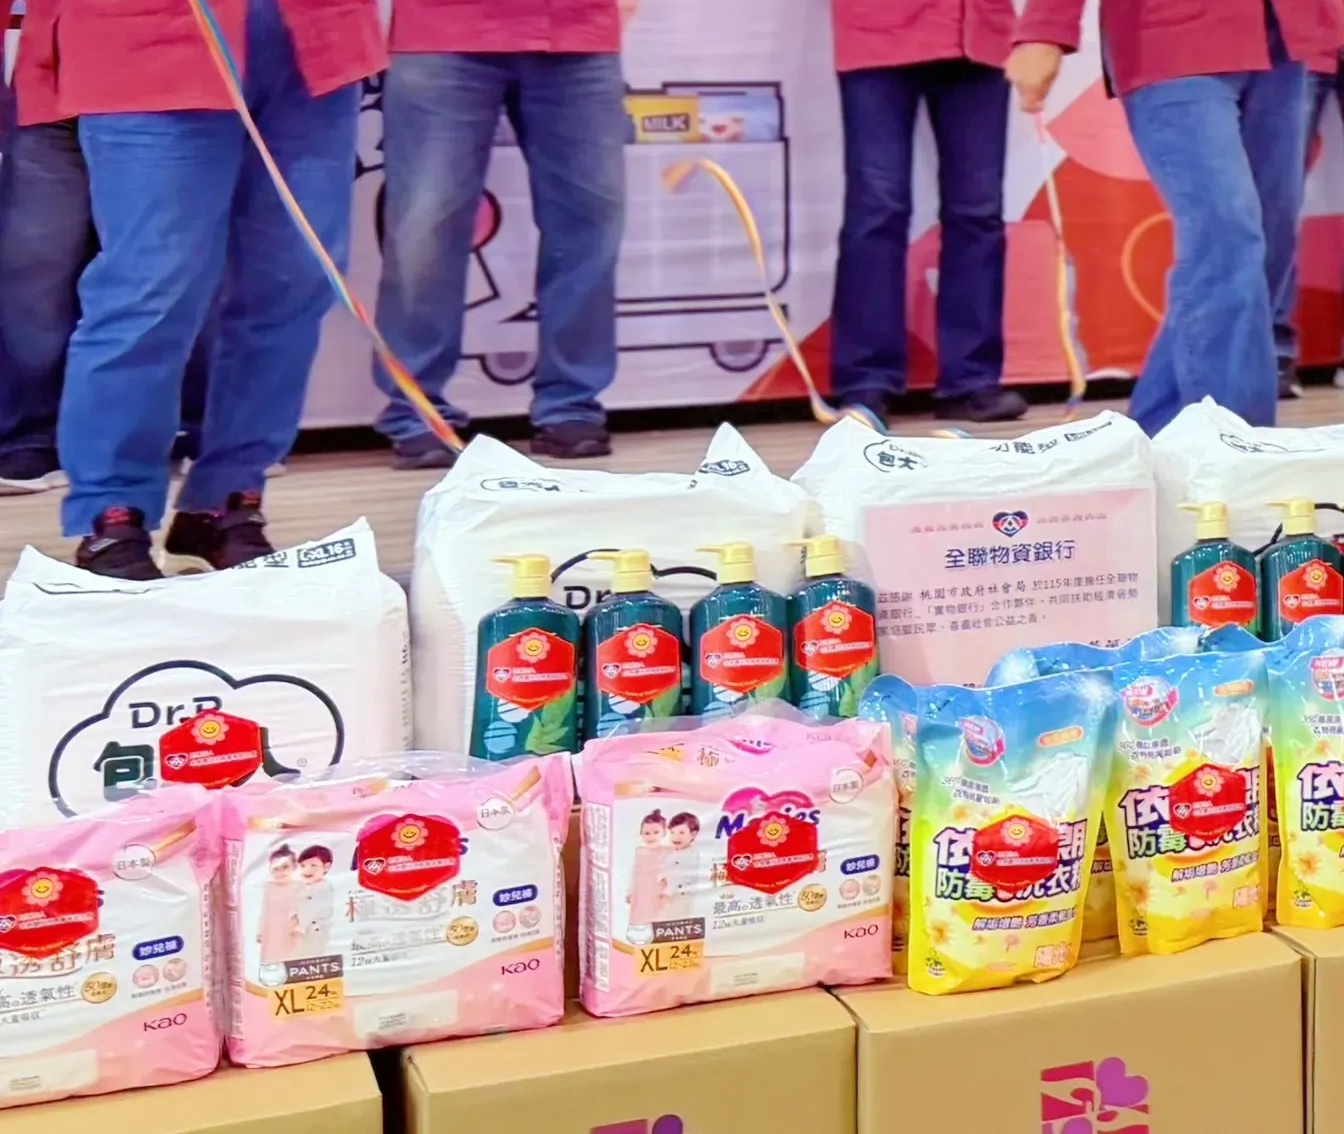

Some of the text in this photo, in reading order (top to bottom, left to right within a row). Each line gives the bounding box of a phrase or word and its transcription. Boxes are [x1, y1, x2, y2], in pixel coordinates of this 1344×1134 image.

[643, 115, 687, 132] MILK
[944, 539, 1076, 569] 全聯物資銀行
[920, 579, 1027, 600] 桃園市政府社會局
[656, 923, 702, 937] PANTS
[289, 961, 341, 977] PANTS
[640, 944, 692, 973] XL 24
[275, 985, 330, 1016] XL 24
